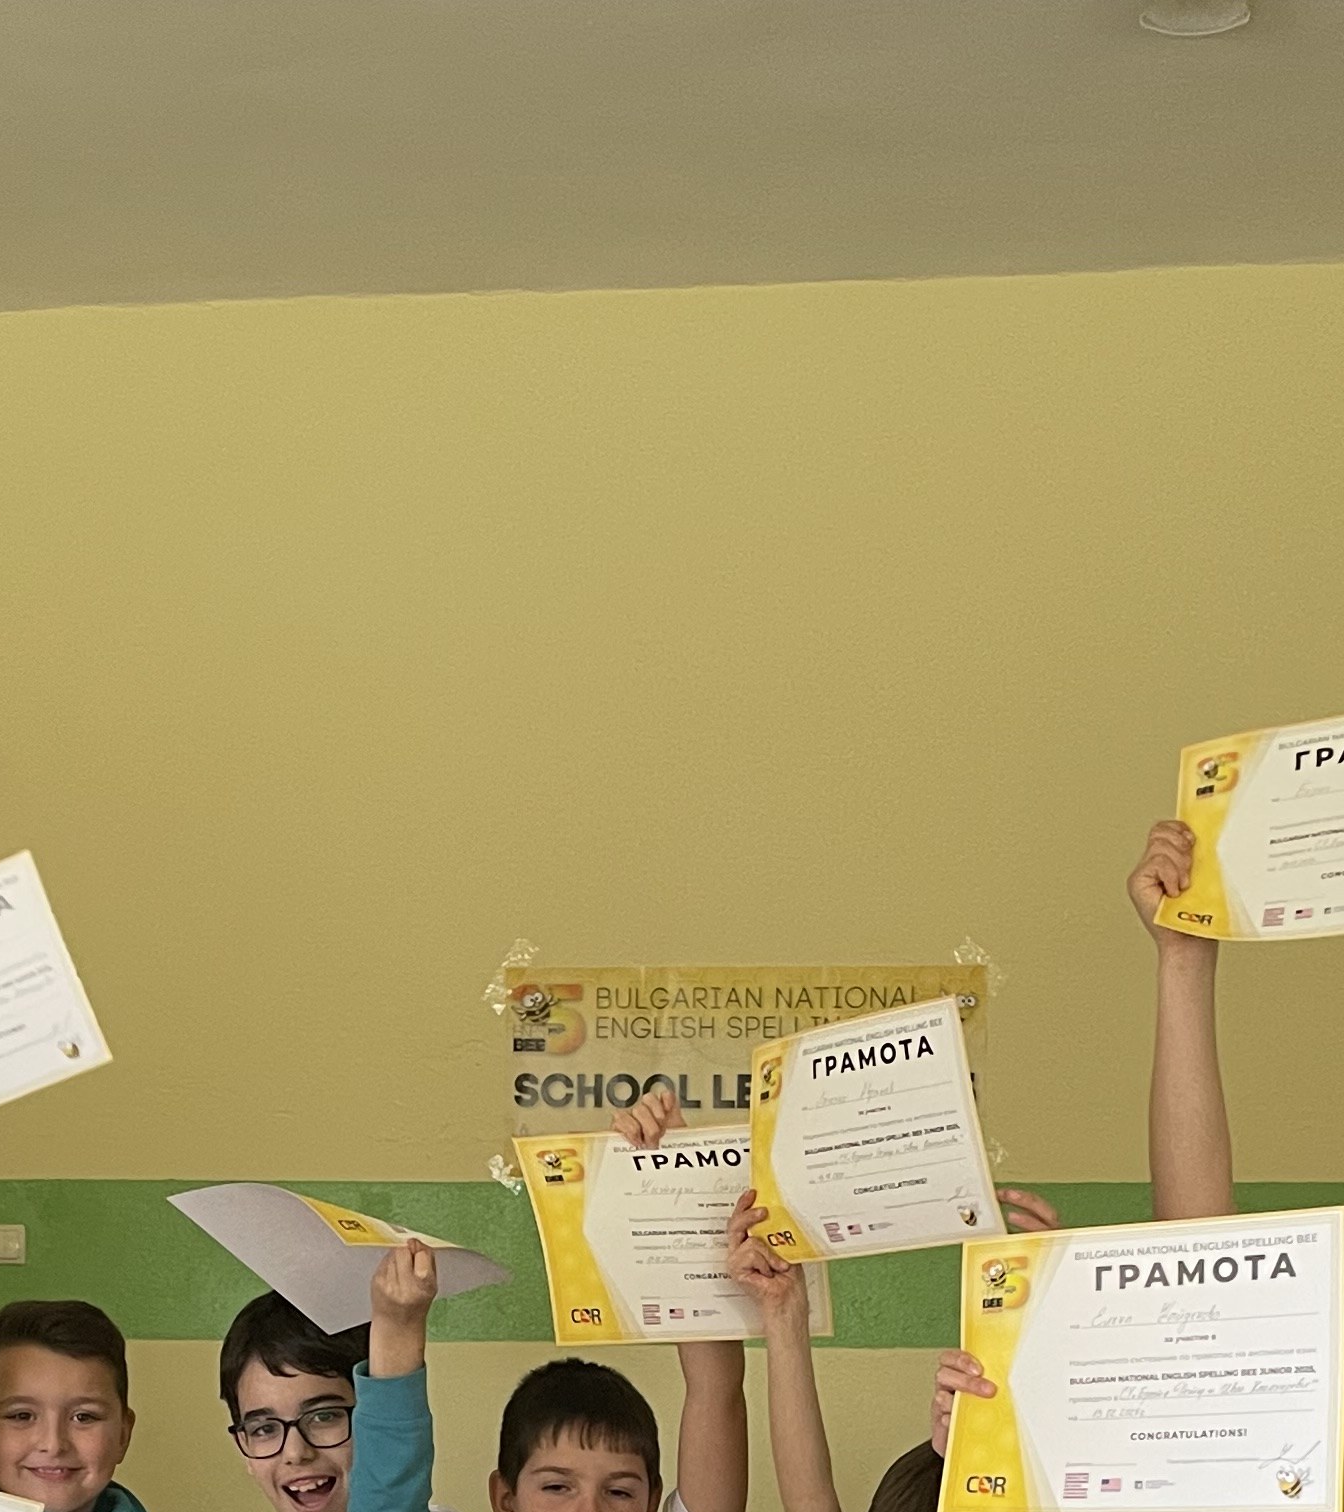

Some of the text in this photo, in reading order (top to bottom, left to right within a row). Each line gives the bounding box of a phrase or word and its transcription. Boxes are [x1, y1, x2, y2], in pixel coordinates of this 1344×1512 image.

[596, 985, 919, 1010] BULGARIAN NATIONAL
[596, 1016, 715, 1038] ENGLISH
[812, 1033, 933, 1079] ГРАМОТА
[514, 1073, 701, 1109] SCHOOL
[633, 1149, 750, 1171] ГРАМО
[1074, 1233, 1317, 1260] BULGARIAN NATIONAL ENGLISH SPELLING BEE
[1094, 1252, 1297, 1291] ГРАМОТА
